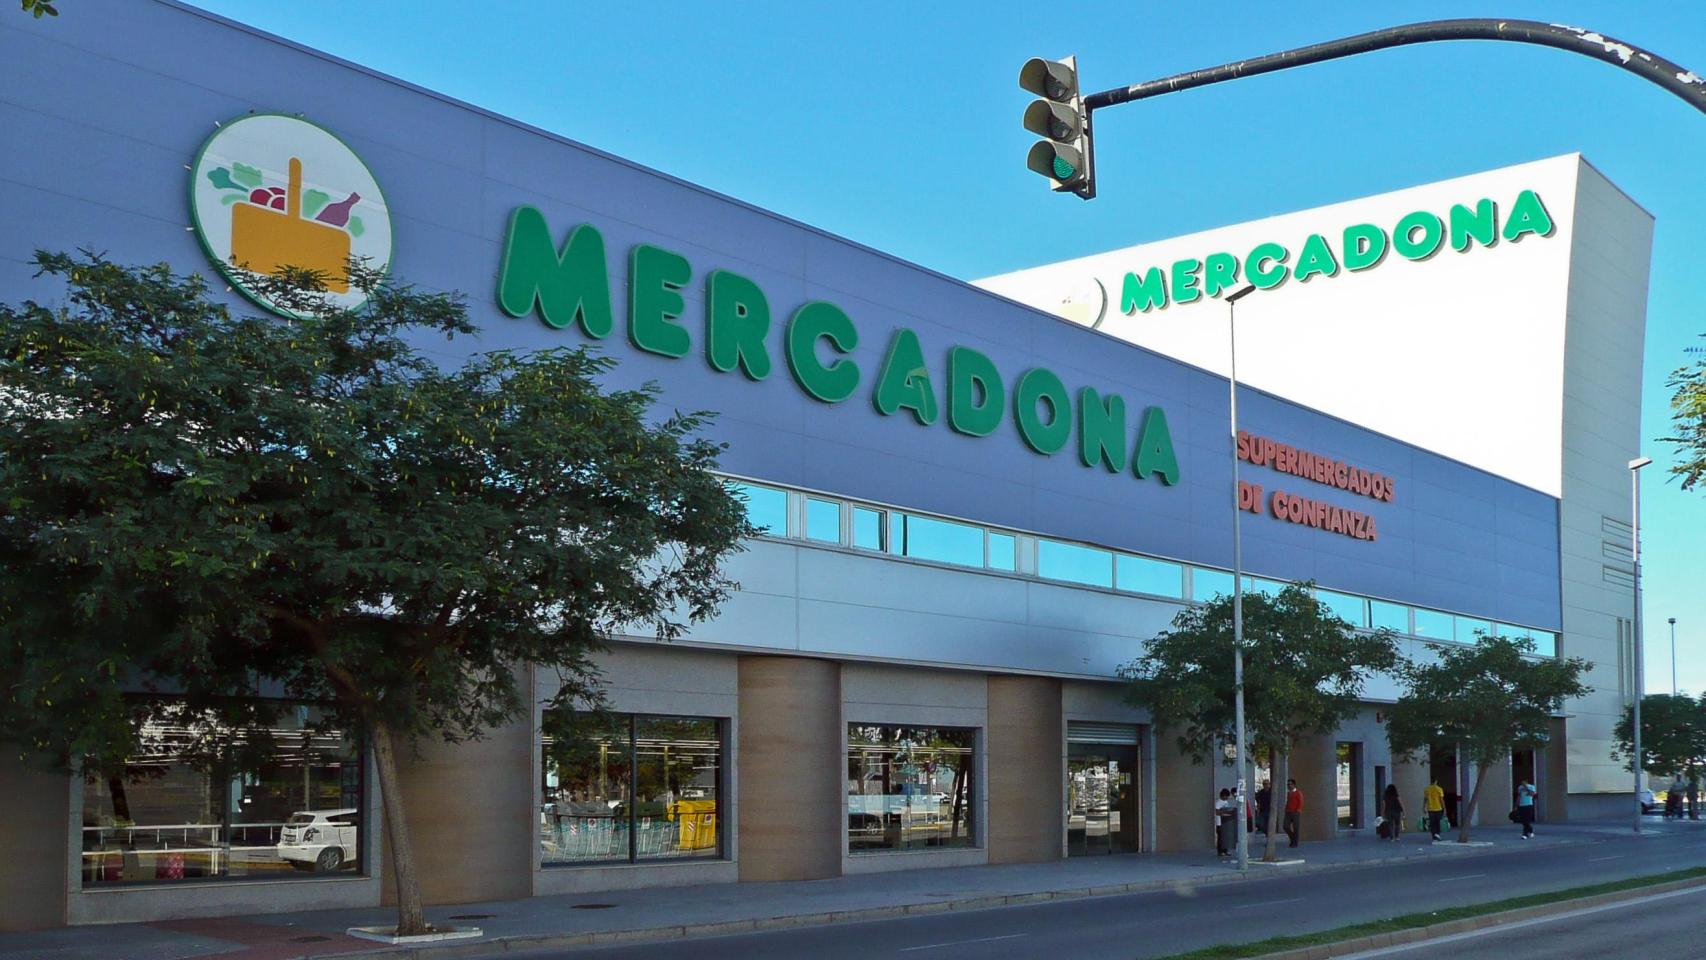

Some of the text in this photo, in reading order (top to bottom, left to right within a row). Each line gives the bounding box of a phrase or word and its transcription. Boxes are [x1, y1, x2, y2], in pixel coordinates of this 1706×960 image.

[1120, 190, 1556, 315] MERCADONA
[499, 205, 1180, 486] MERCADONA
[1237, 431, 1394, 502] SUPERMERCADOS
[1272, 491, 1377, 541] CONFIANZA
